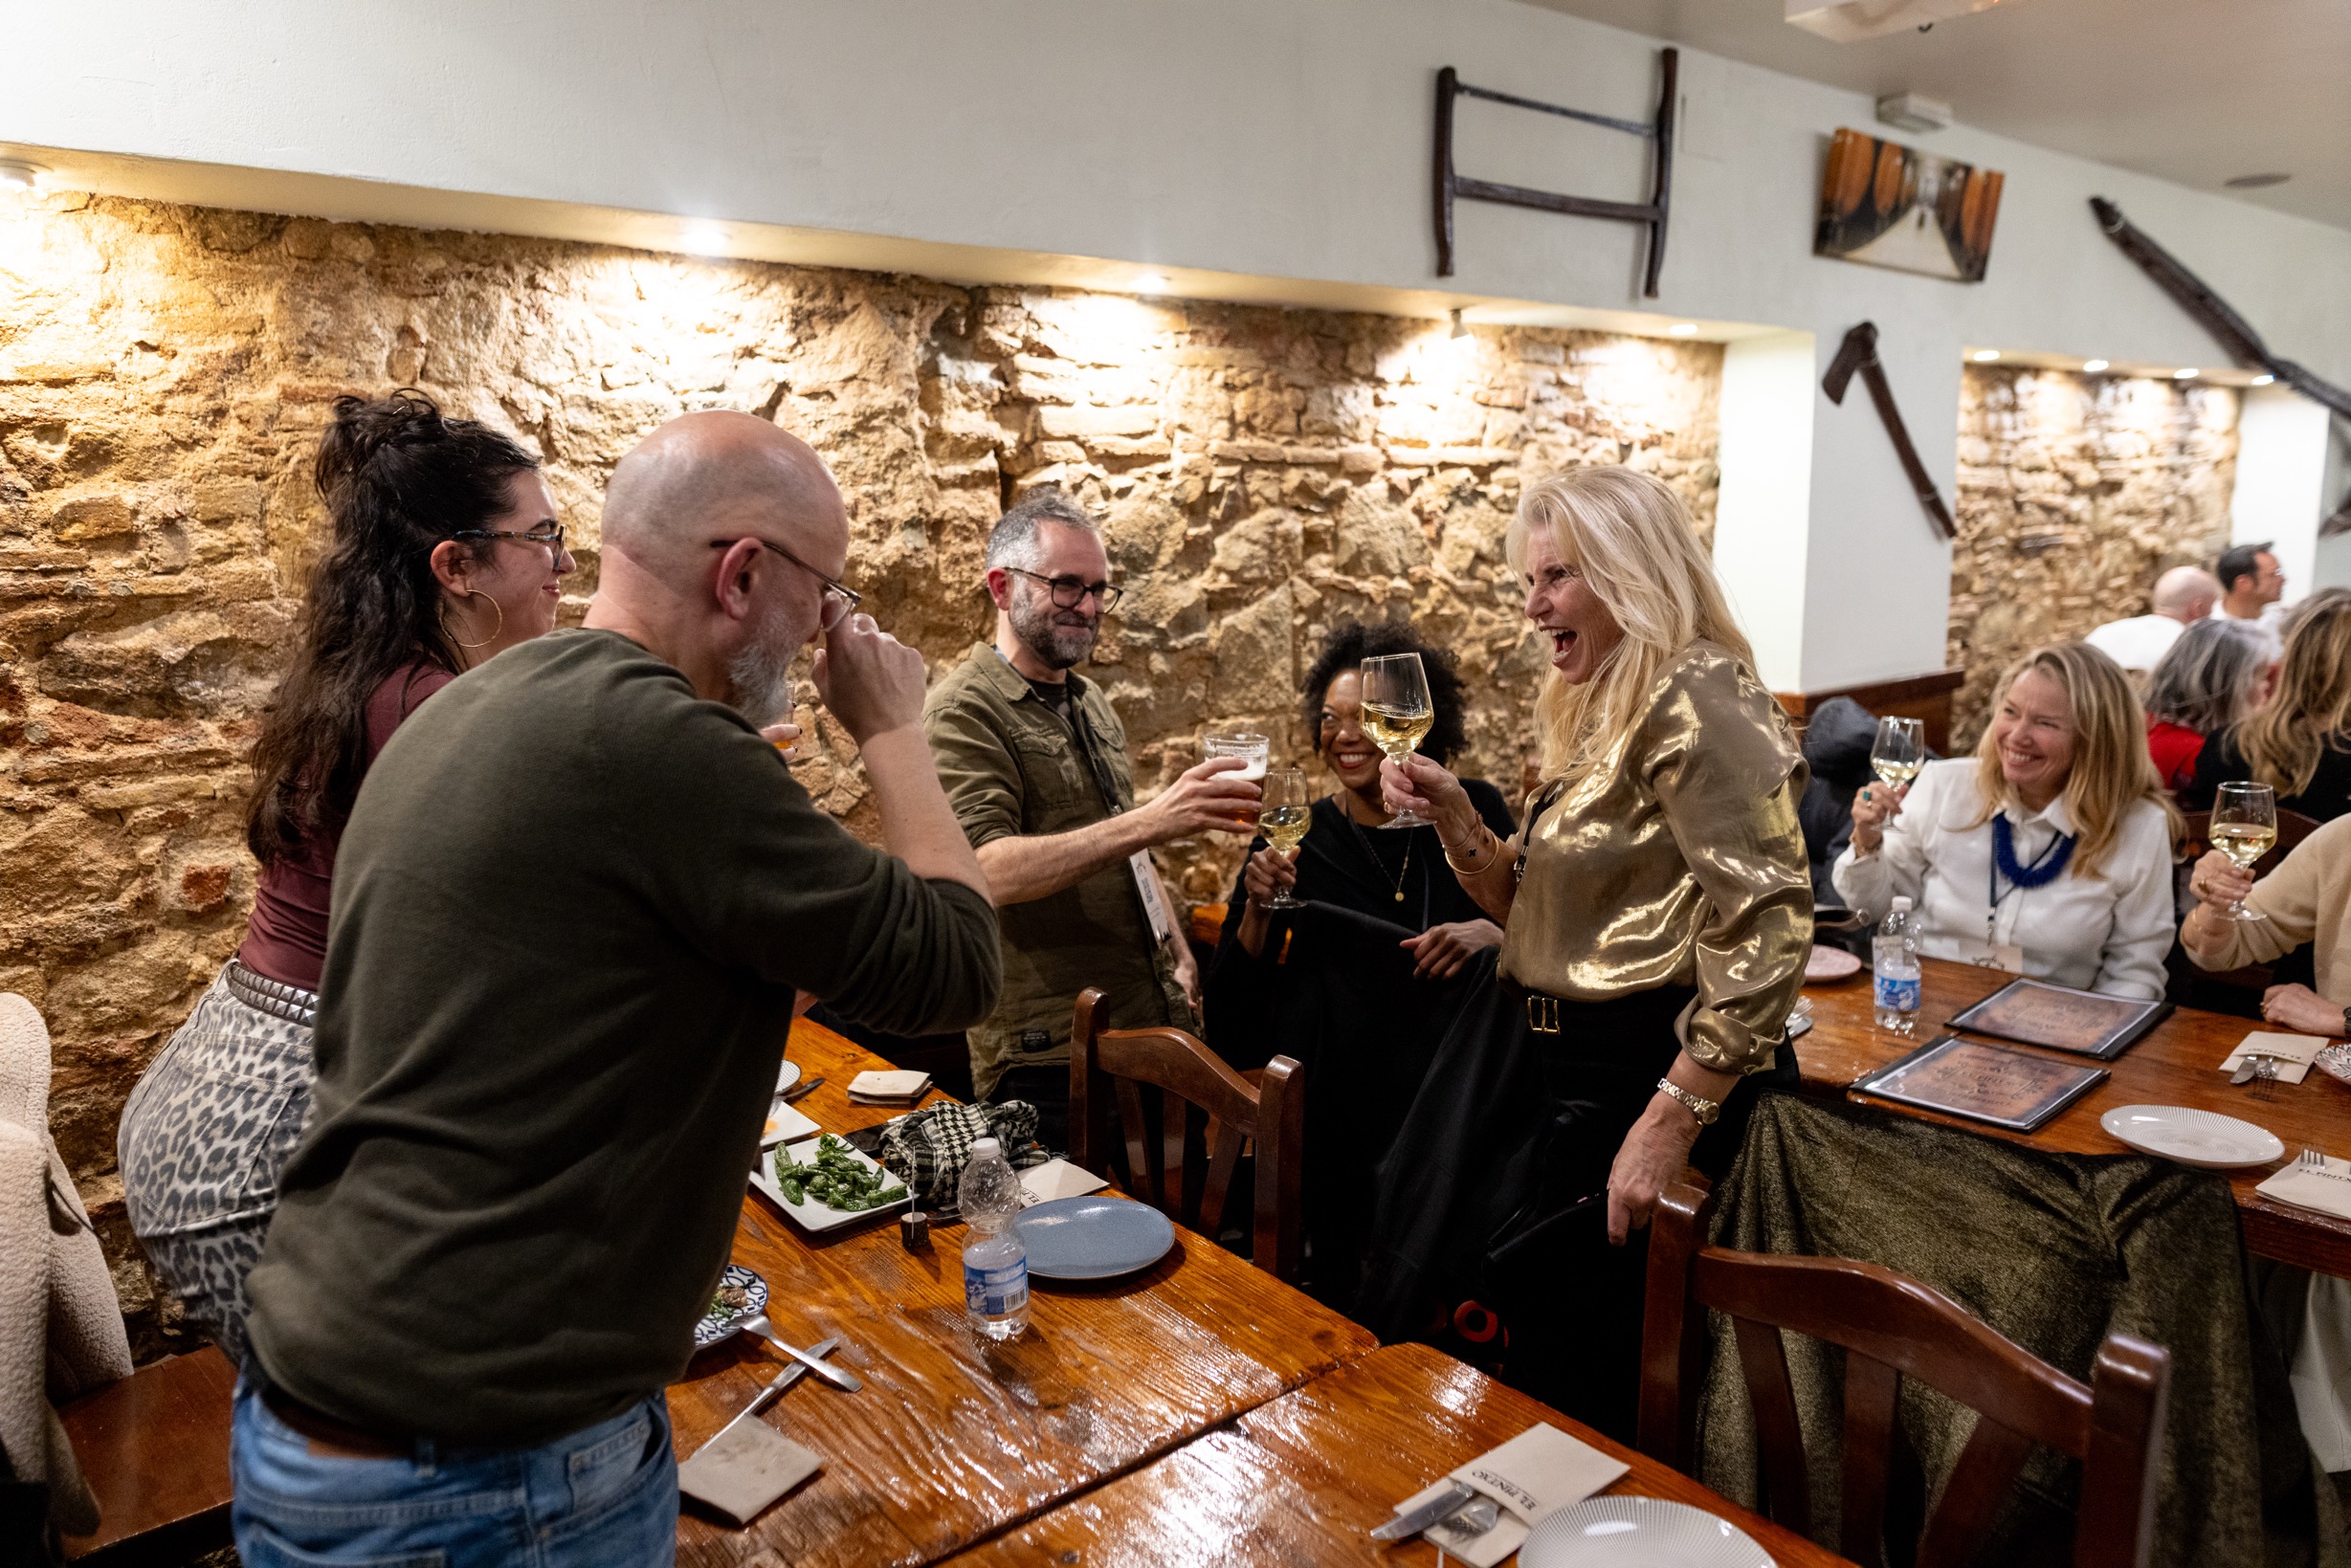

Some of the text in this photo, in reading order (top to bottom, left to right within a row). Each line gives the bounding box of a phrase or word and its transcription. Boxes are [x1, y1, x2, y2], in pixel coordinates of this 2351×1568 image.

[1028, 1194, 1040, 1204] EL
[1472, 1469, 1537, 1511] EL PINTXO
